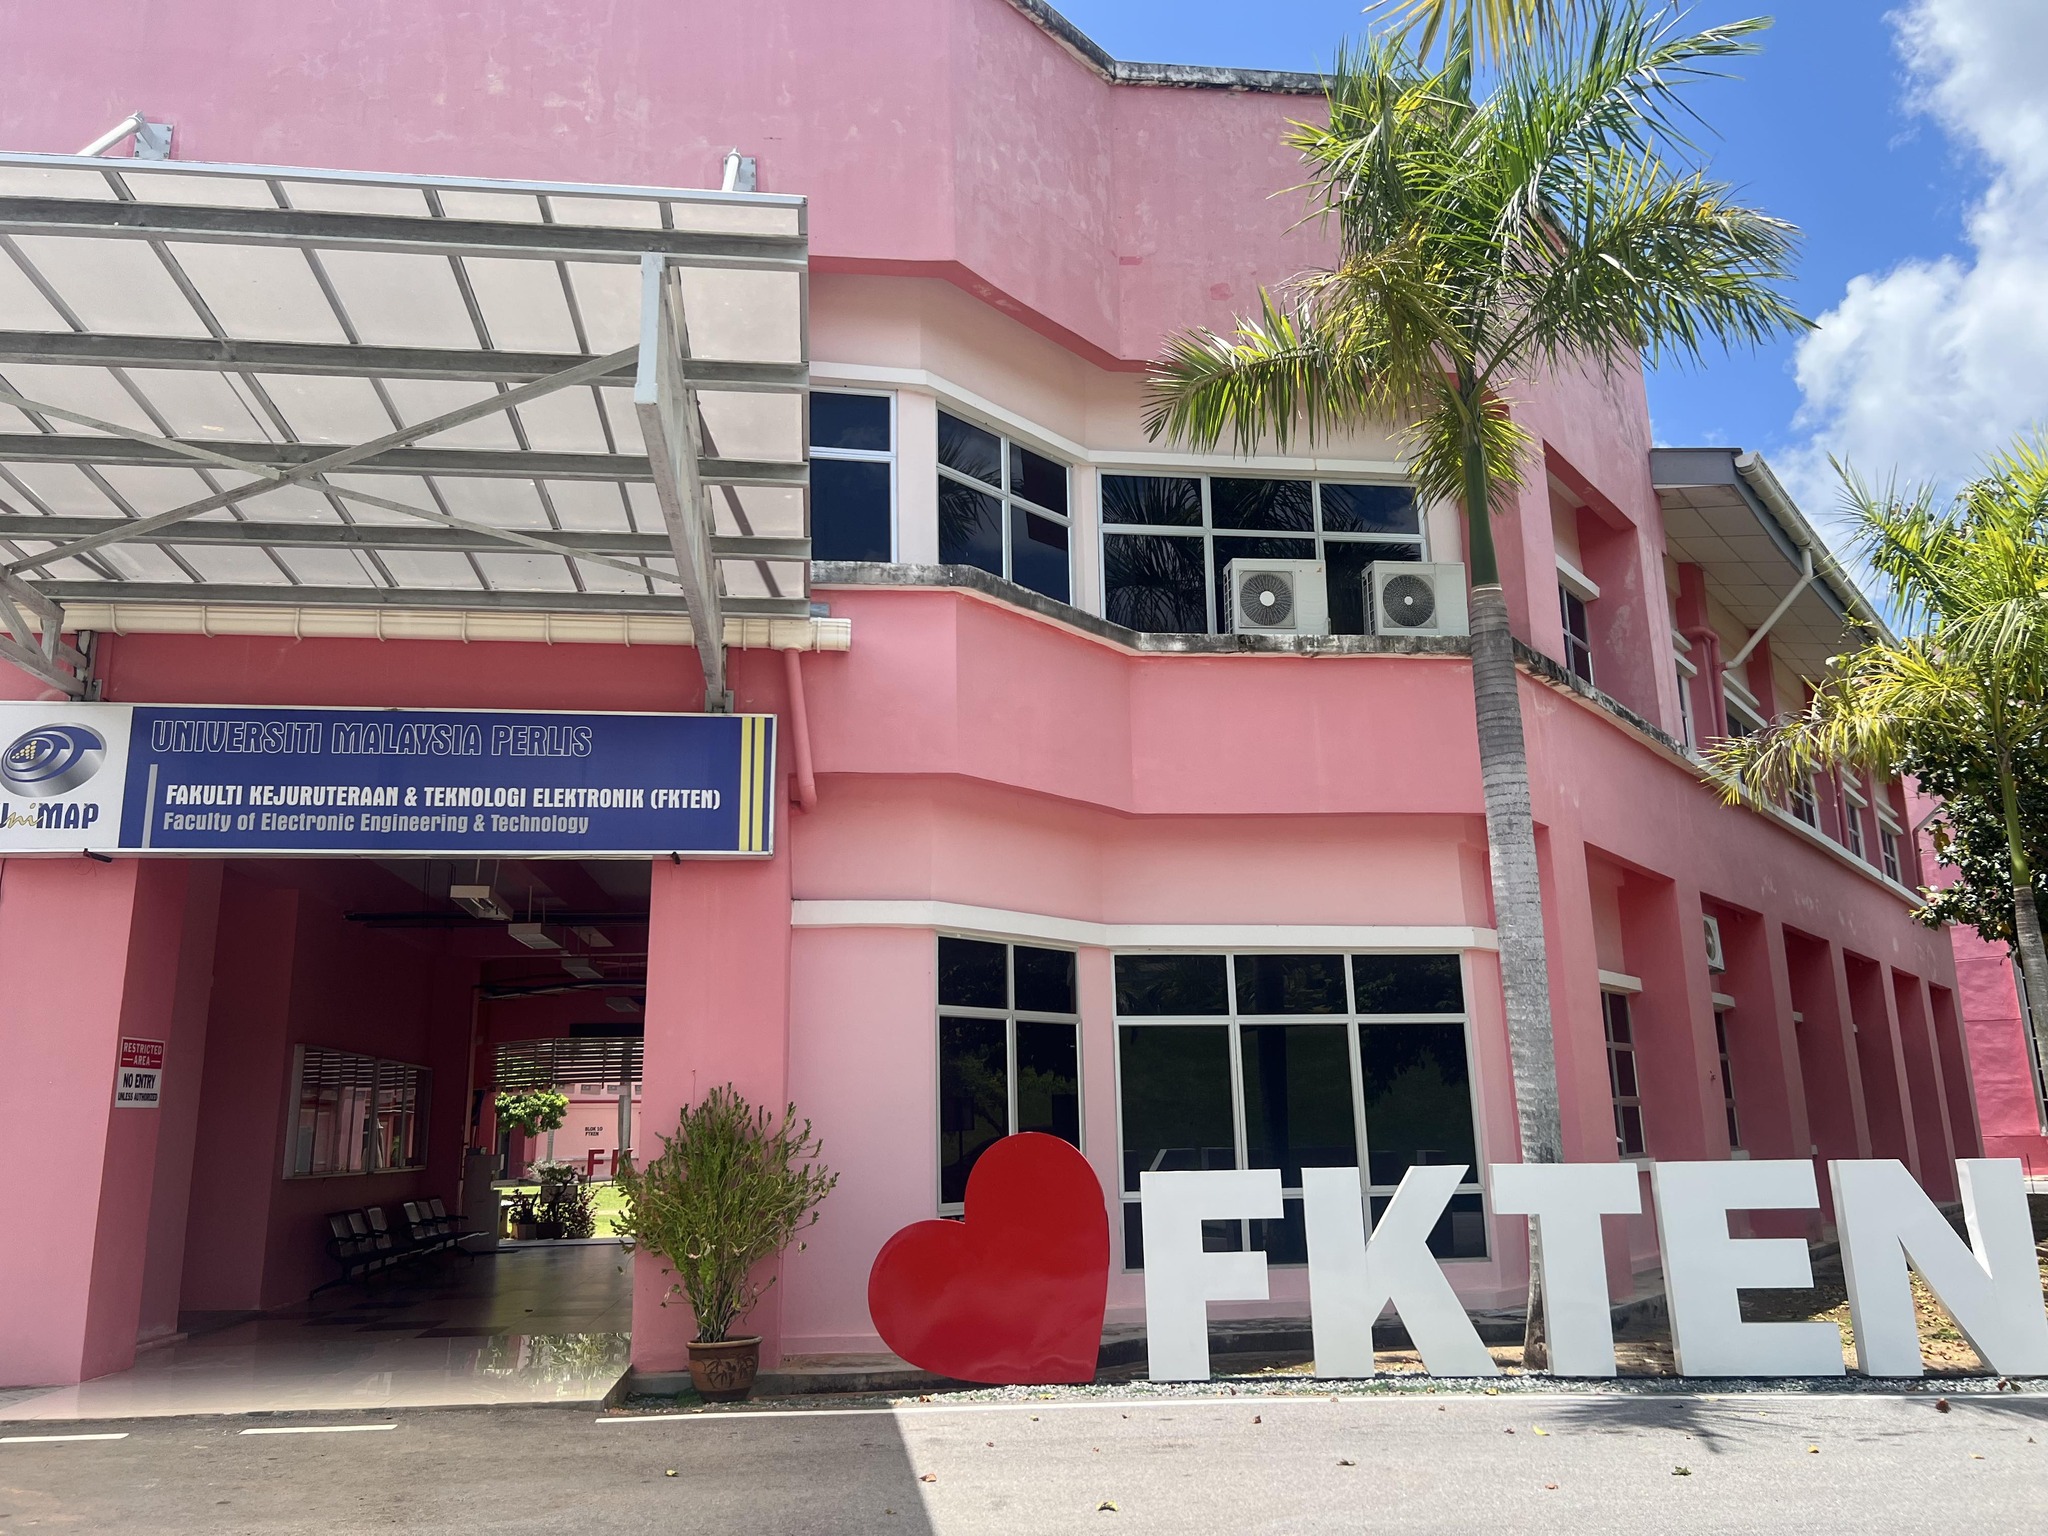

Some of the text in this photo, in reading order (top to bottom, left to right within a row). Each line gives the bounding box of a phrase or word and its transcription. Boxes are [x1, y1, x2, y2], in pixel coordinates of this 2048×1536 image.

[151, 720, 593, 758] UNIVERSITI MALAYSIA PERLIS
[165, 785, 721, 810] FAKULTI KEJURUTERAAN & TEKNOLOGI ELEKTRONIK (FKTEN)
[163, 812, 589, 834] Faculty of Electronic Engineering & Technology
[123, 1042, 163, 1055] RESTRICTED
[133, 1055, 150, 1066] AREA
[123, 1073, 156, 1089] NO ENTRY
[118, 1092, 133, 1101] UNLESS
[1139, 1159, 2048, 1380] FKTEN
